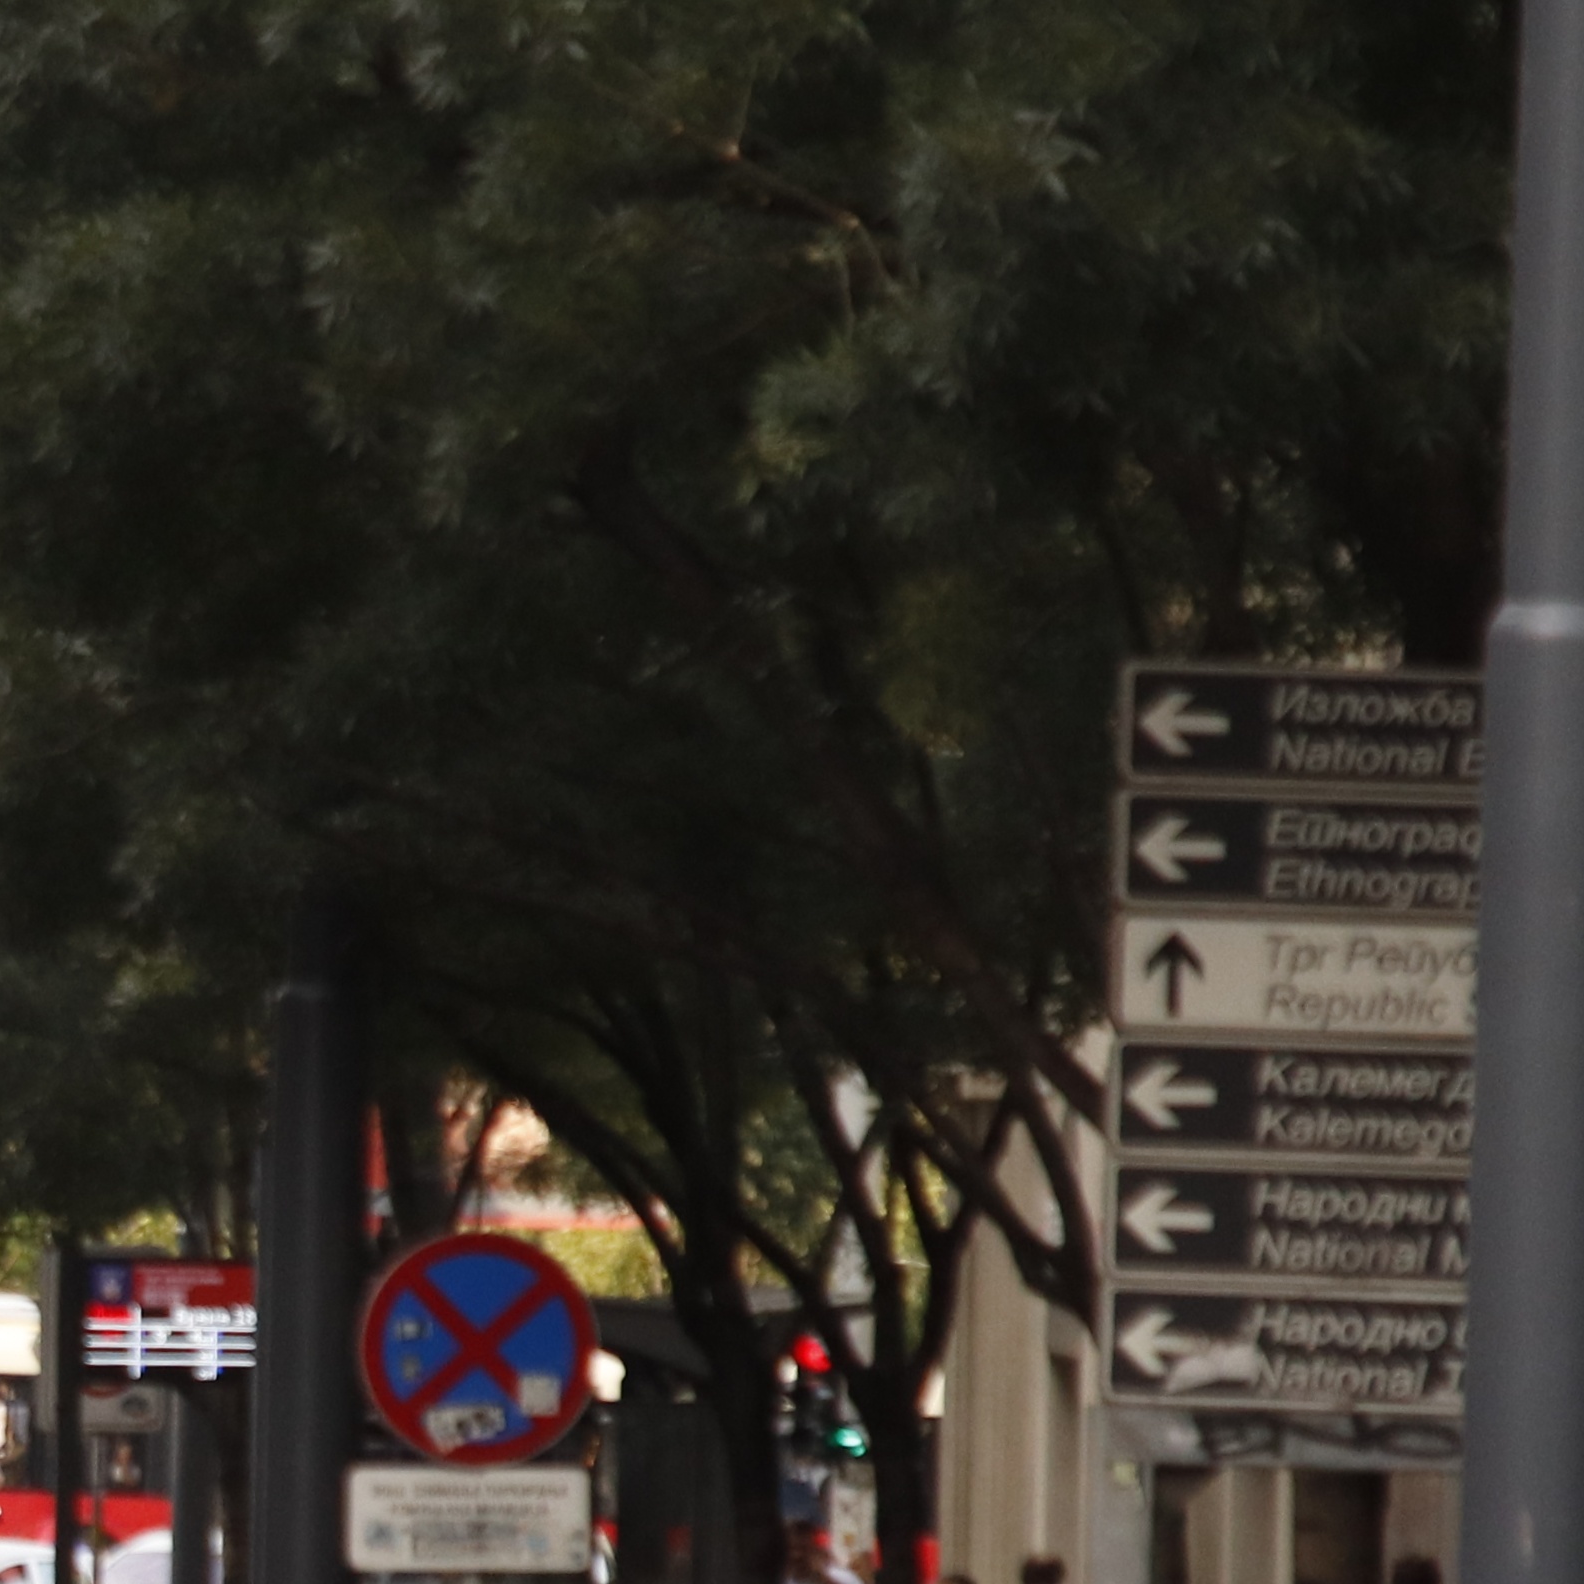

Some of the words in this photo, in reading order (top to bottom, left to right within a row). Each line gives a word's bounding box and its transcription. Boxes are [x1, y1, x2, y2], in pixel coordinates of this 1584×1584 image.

[1272, 730, 1449, 776] National
[1266, 984, 1448, 1030] Republic
[1252, 1180, 1446, 1228] Народни
[1251, 1228, 1430, 1273] National
[1252, 1303, 1447, 1354] Народно
[1256, 1354, 1429, 1398] National
